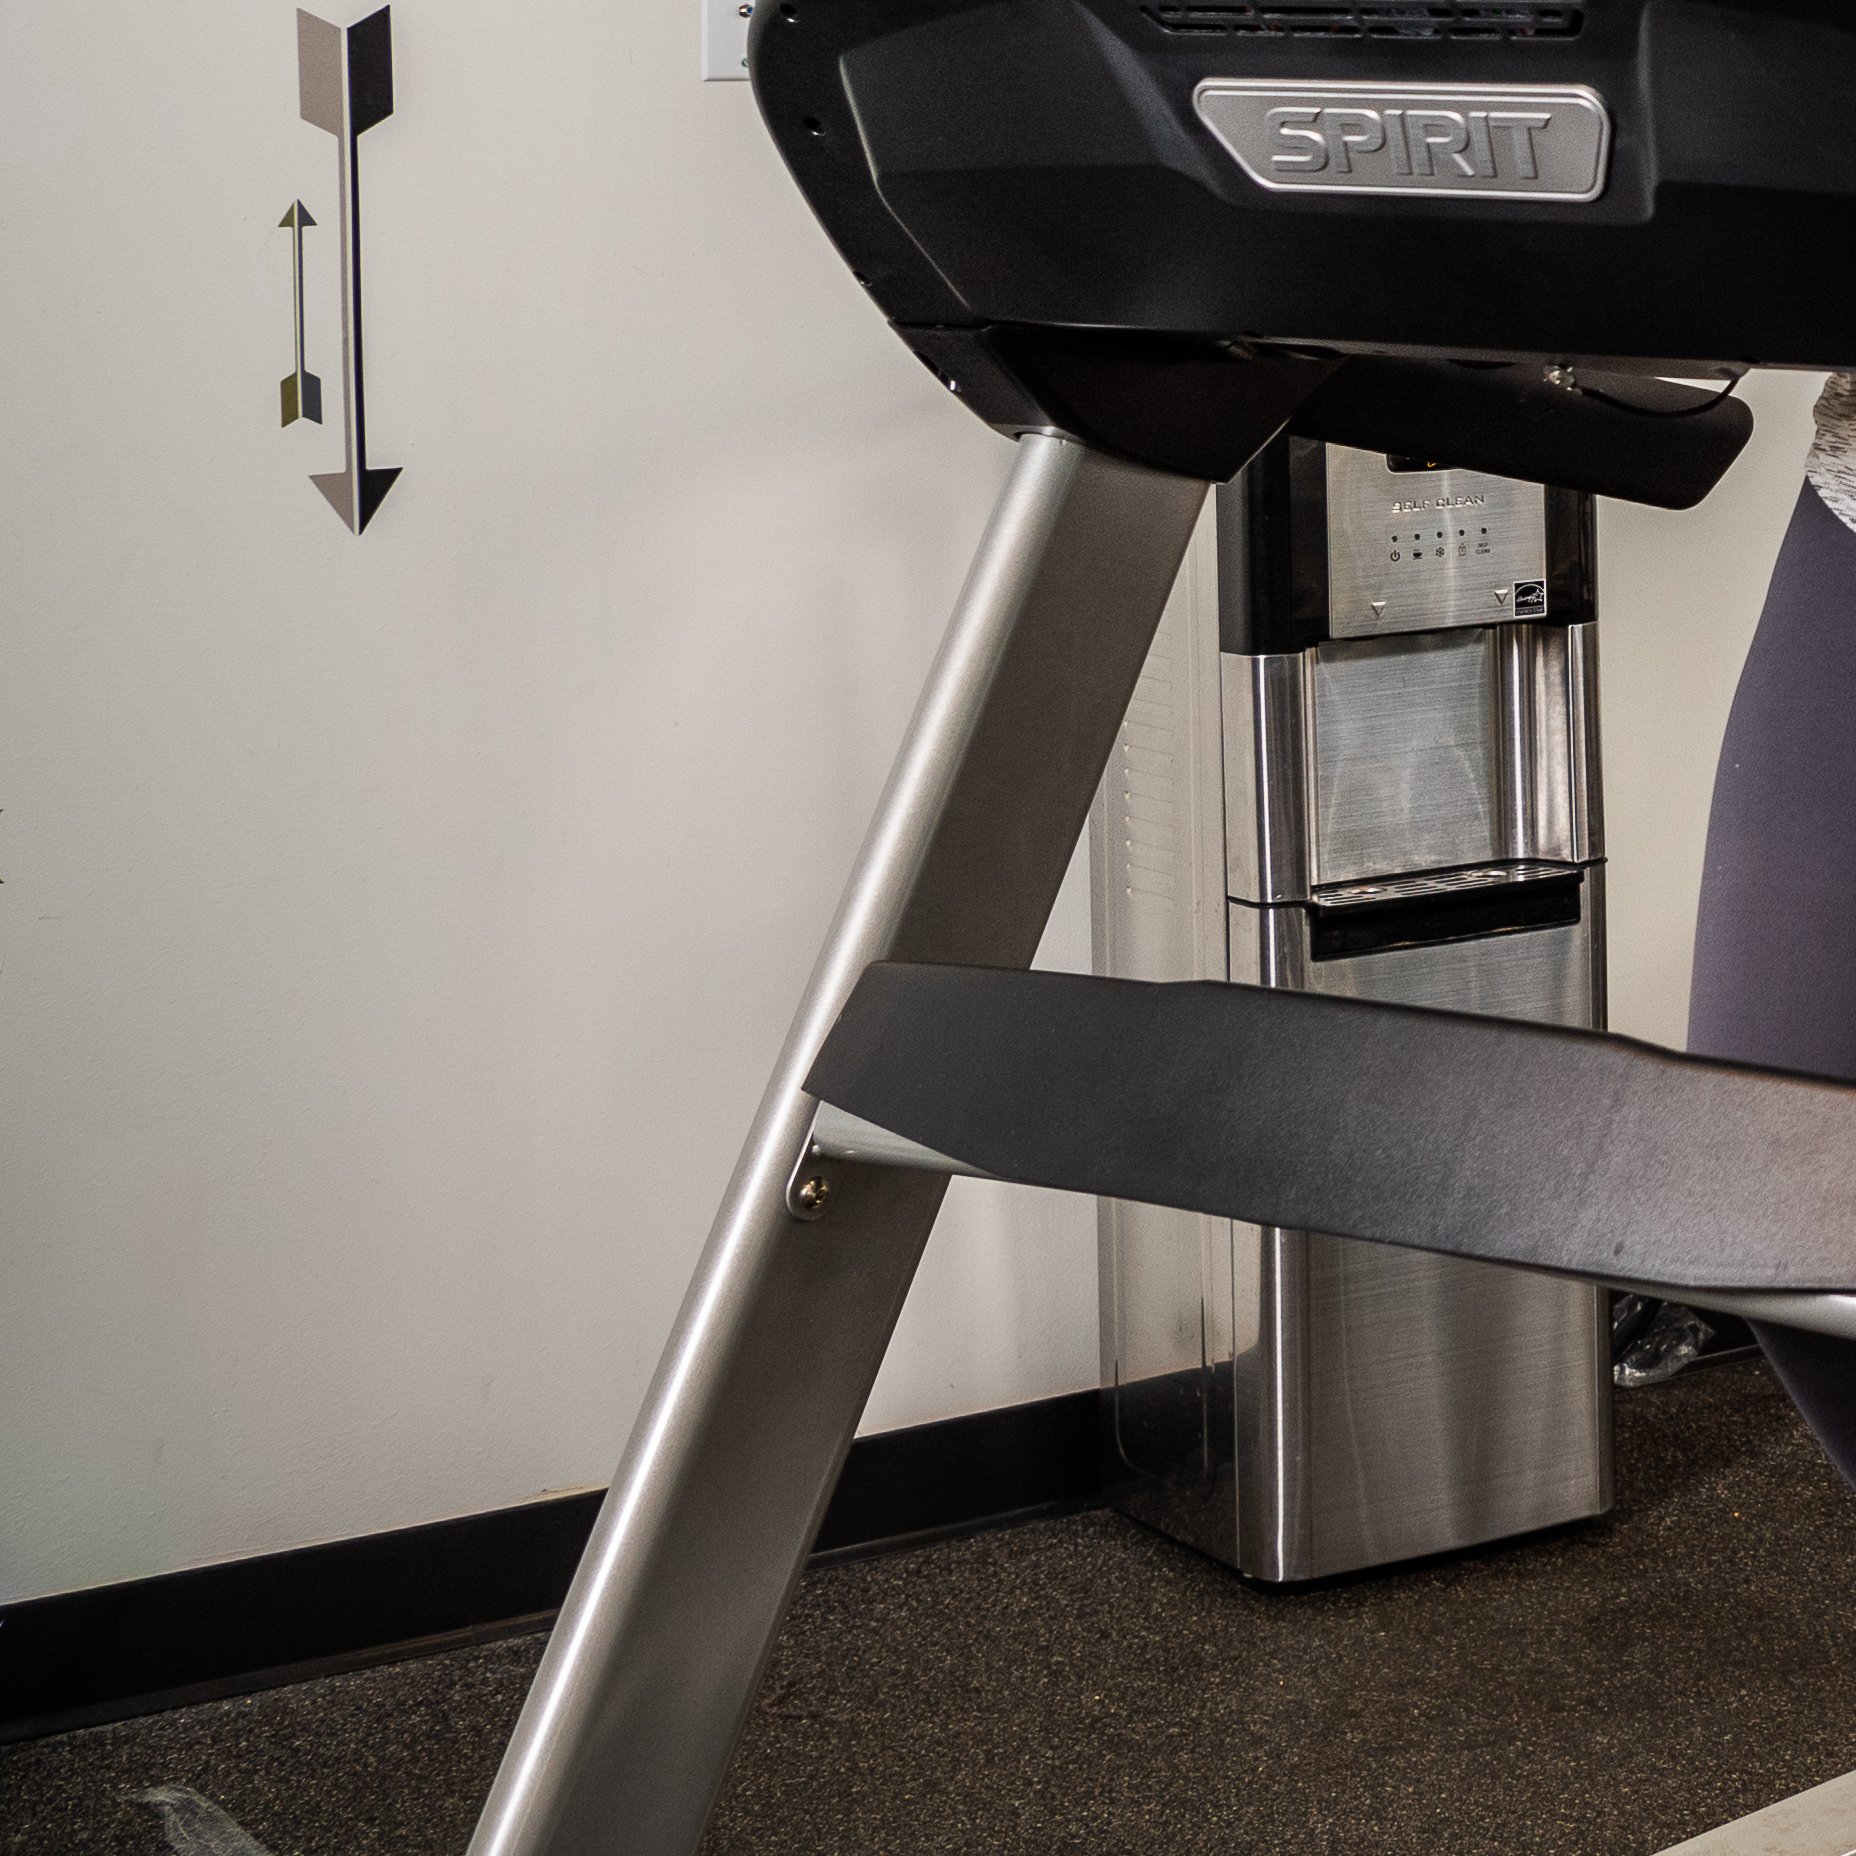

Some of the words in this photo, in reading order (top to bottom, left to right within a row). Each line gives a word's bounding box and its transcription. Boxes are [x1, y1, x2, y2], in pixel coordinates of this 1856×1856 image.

[1264, 105, 1552, 181] SPIRIT
[1391, 499, 1431, 514] SELF
[1436, 494, 1485, 510] CLEAN
